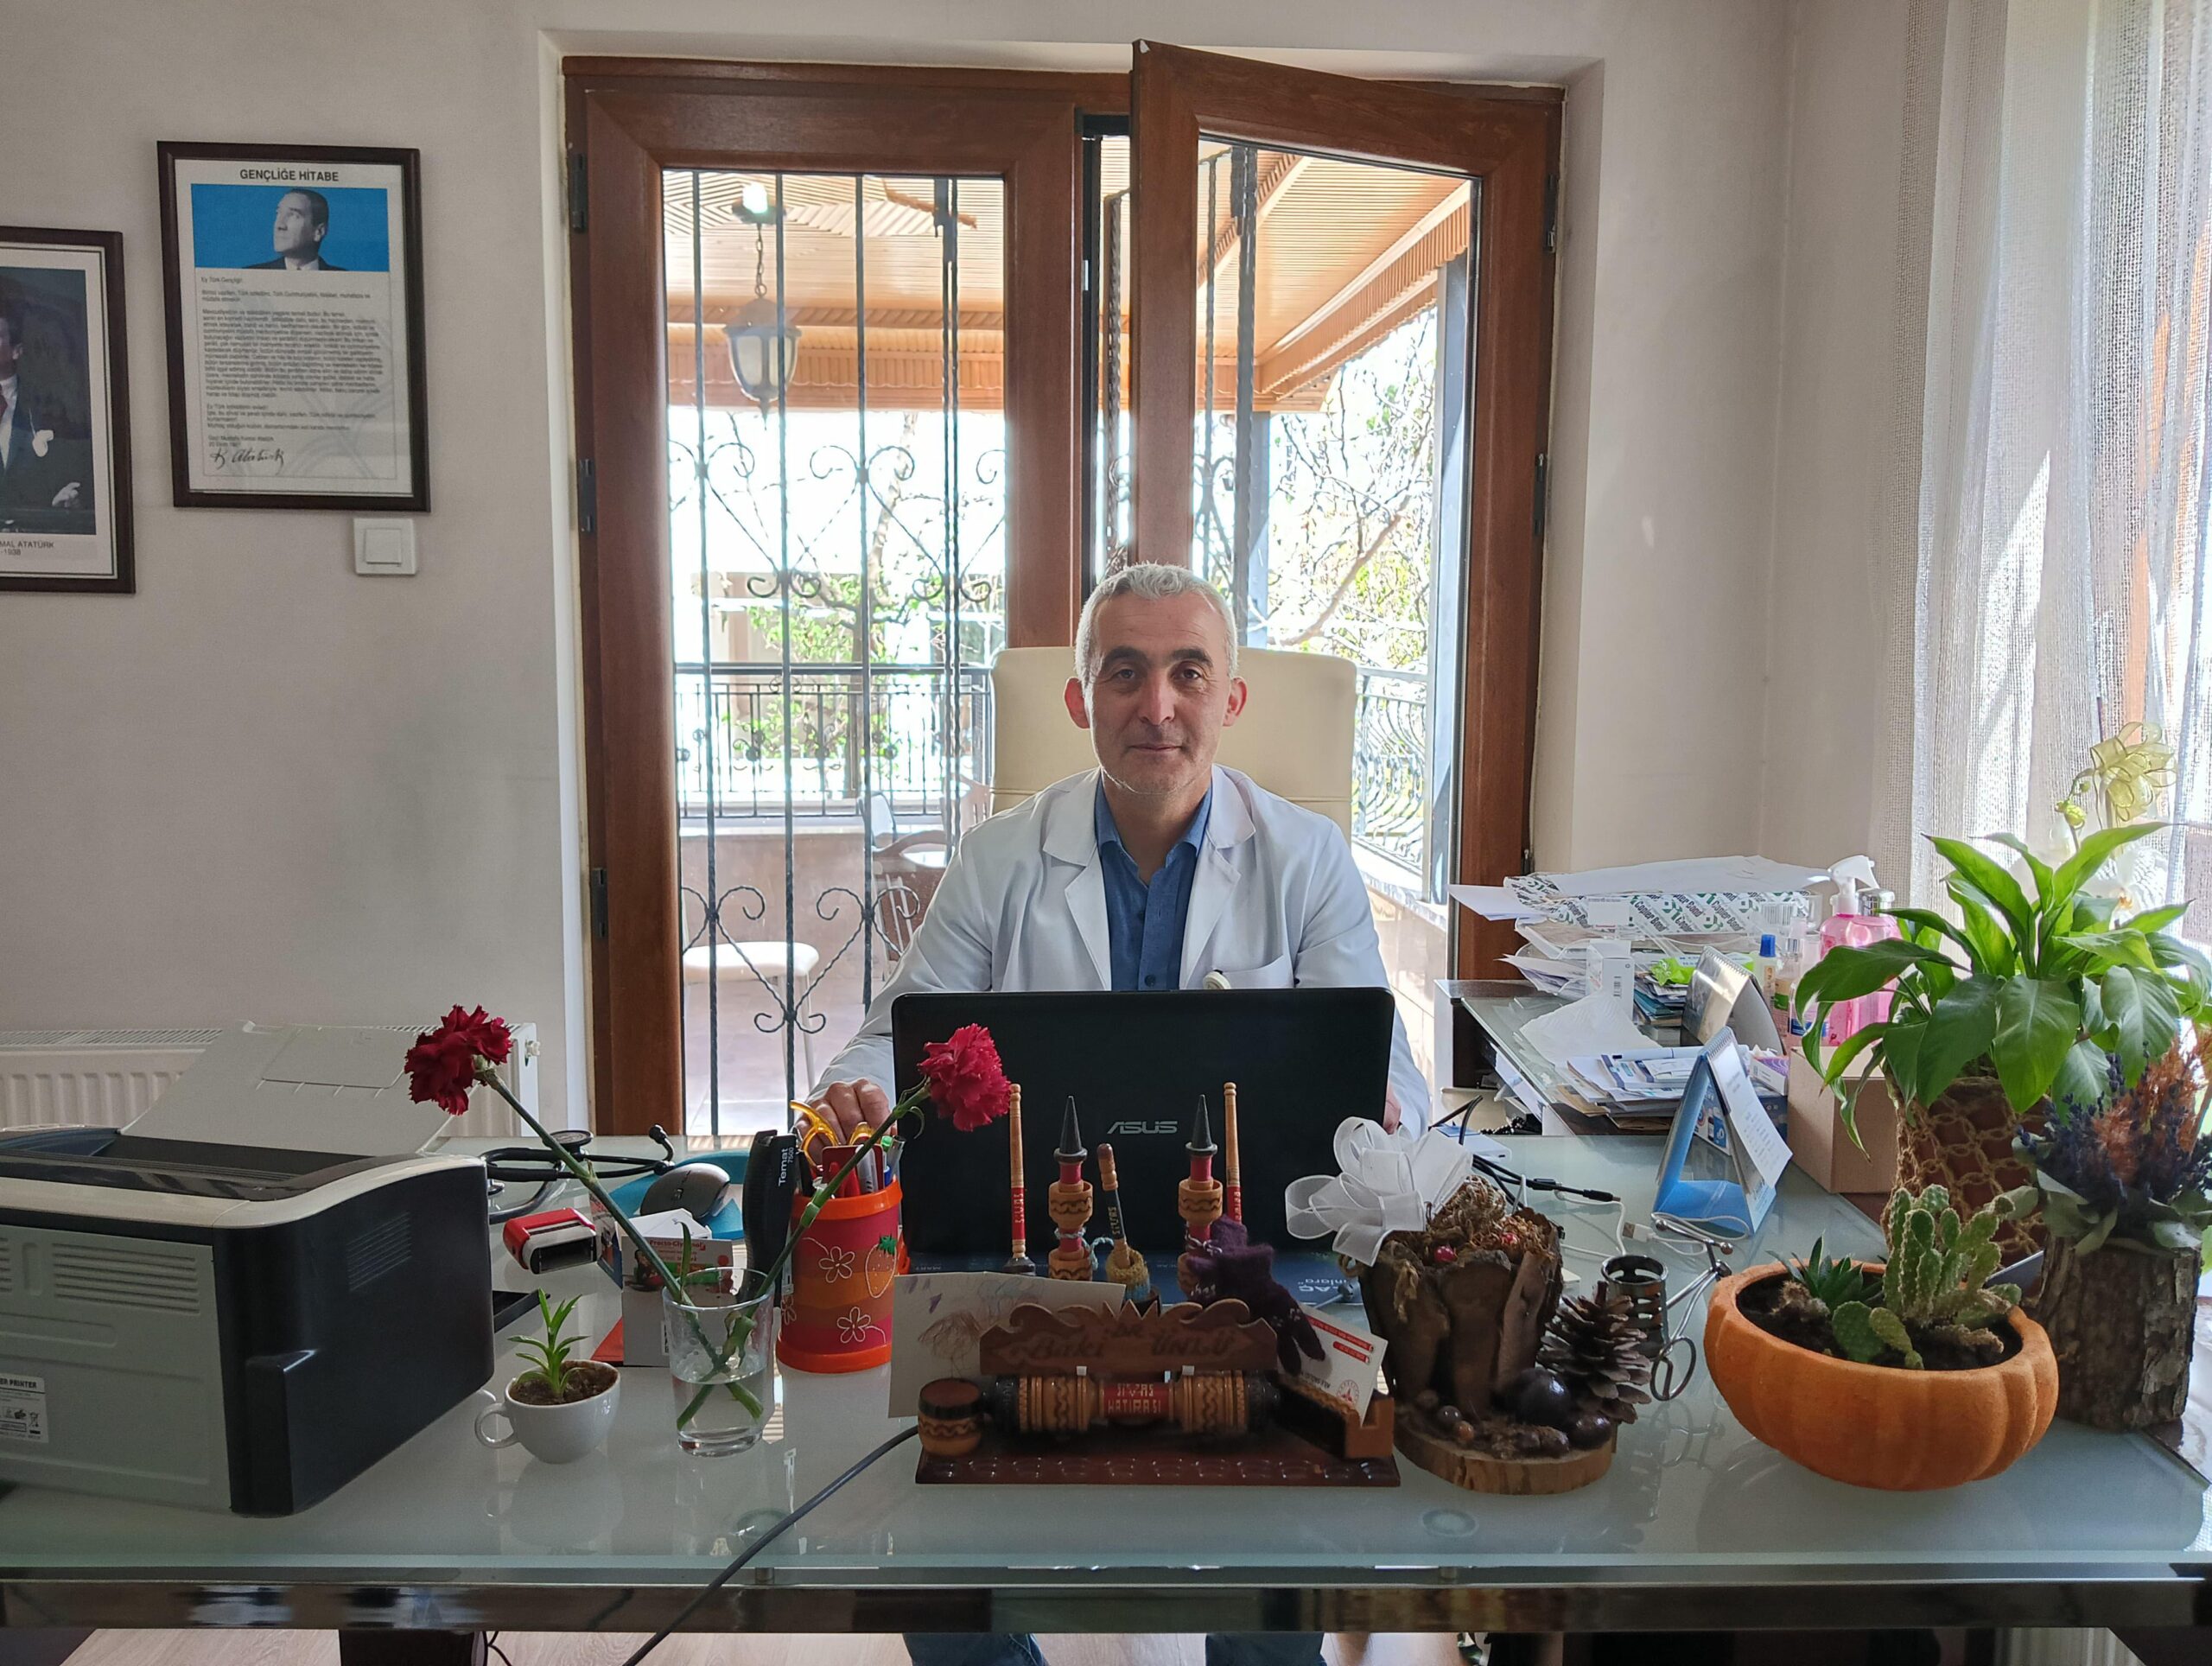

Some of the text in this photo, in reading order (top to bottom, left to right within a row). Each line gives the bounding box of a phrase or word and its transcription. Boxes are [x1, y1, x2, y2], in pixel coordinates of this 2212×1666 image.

[239, 167, 340, 182] GENÇLİĞE HİTABE
[17, 540, 54, 549] ATATÜRK
[1633, 900, 1668, 932] Copier Bond
[1711, 900, 1744, 932] Copier Bond
[1106, 1120, 1179, 1135] ASUS
[778, 1147, 788, 1188] Temat
[9, 1378, 37, 1389] PRINTER
